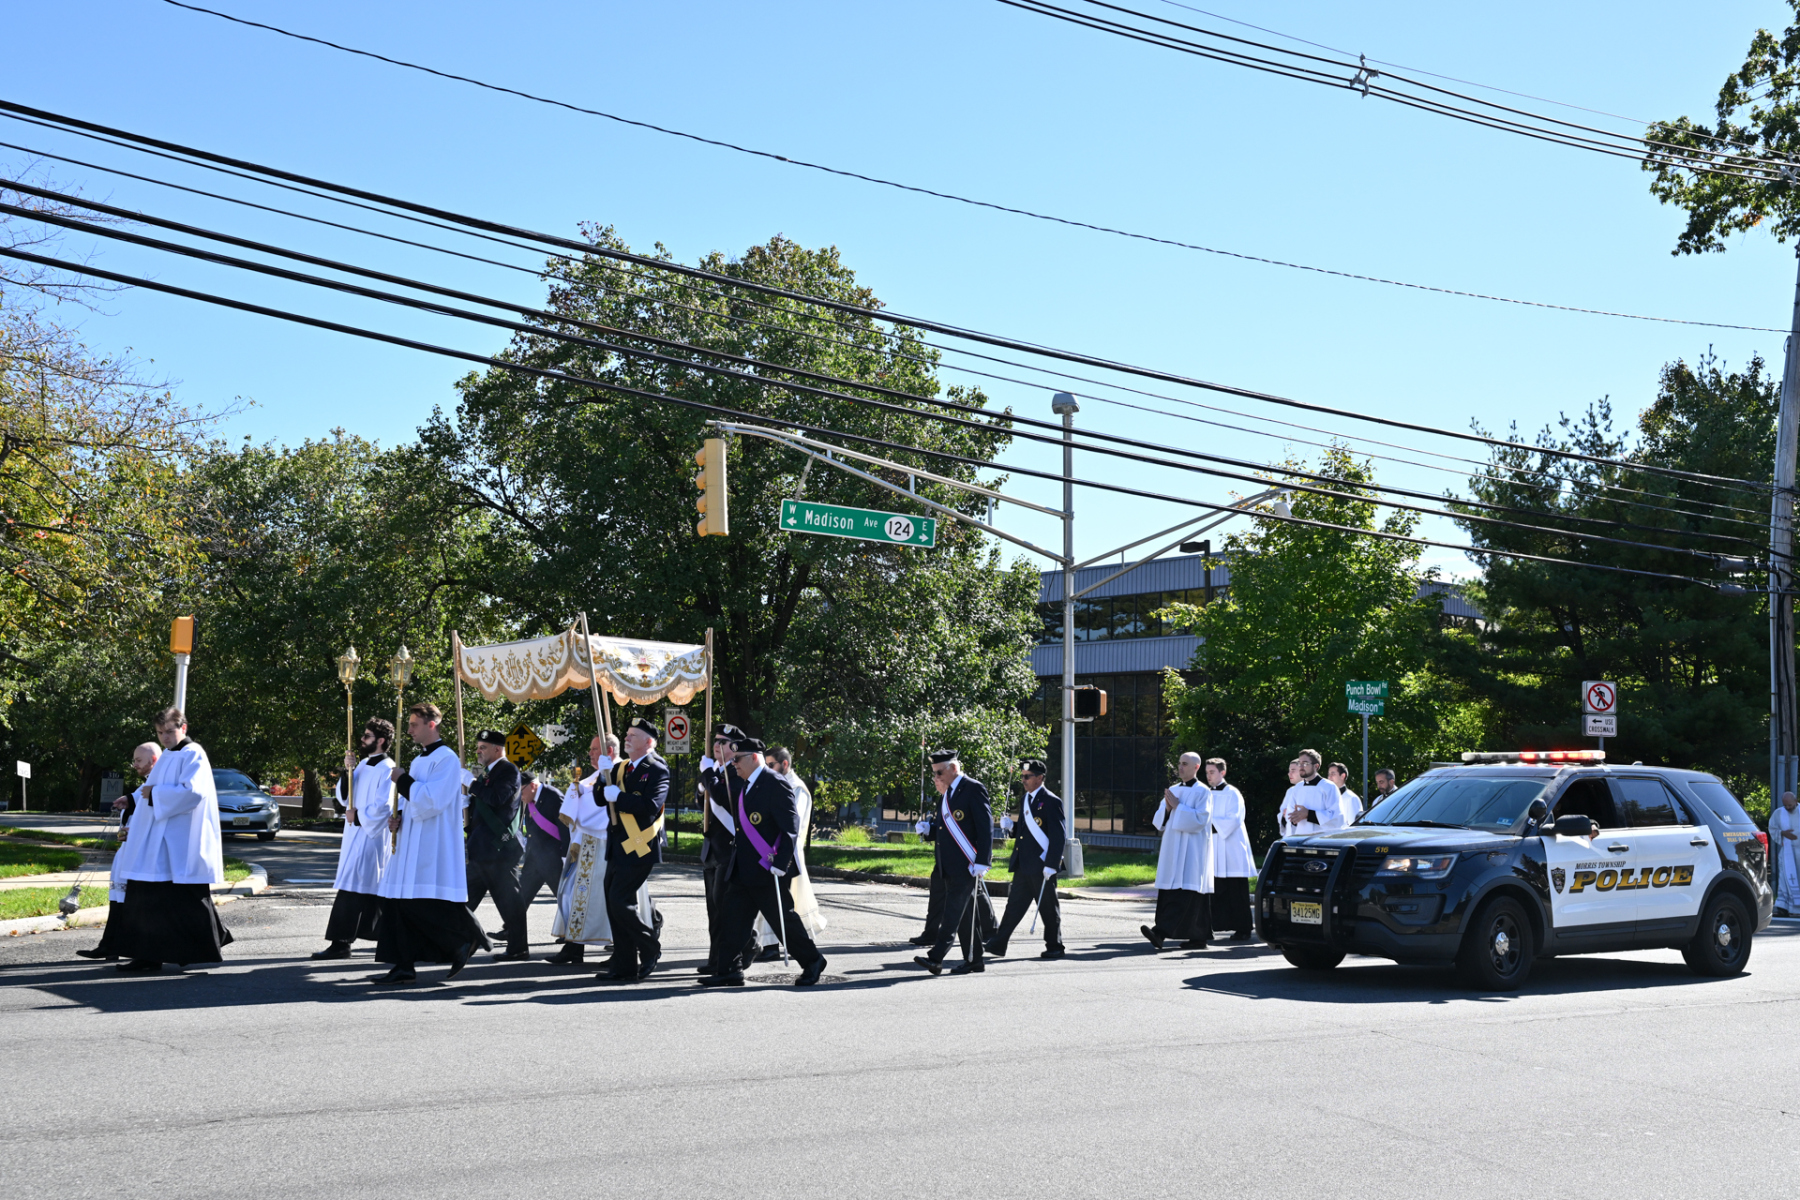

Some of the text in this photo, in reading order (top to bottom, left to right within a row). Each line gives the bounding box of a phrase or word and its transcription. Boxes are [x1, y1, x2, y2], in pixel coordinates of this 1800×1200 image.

[789, 504, 797, 514] W
[804, 509, 878, 530] Madison Ave
[888, 520, 911, 537] 124
[922, 521, 928, 531] E
[1346, 683, 1364, 695] Punch
[1366, 683, 1381, 695] Bowl
[1348, 699, 1378, 712] Madison
[1588, 725, 1614, 733] CROSSWALK
[1575, 861, 1627, 870] MORRIS TOWNSHIP
[1569, 865, 1695, 894] POLICE
[1292, 906, 1320, 919] 34125MG
